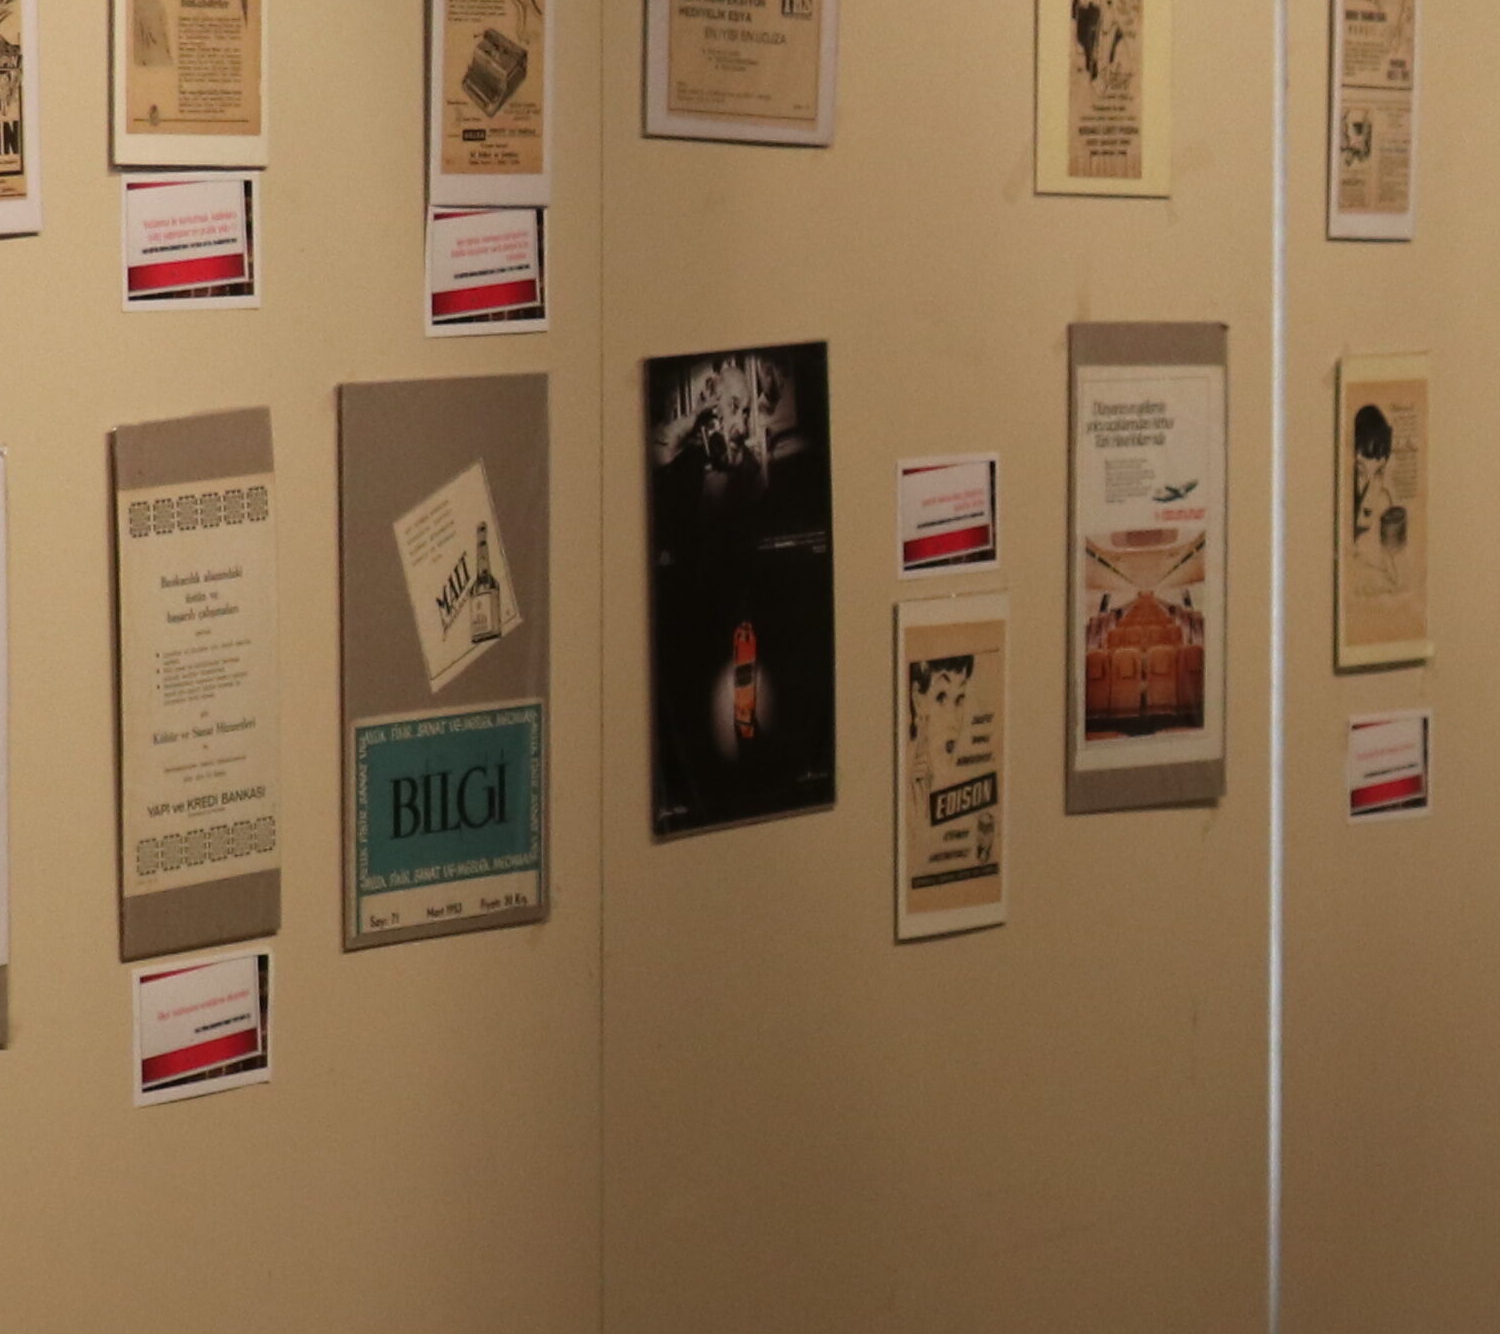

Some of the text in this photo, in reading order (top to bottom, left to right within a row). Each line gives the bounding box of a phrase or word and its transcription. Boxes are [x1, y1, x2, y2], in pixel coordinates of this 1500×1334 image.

[148, 803, 171, 819] YAPI
[172, 803, 185, 814] ve
[220, 784, 266, 805] BANKASI
